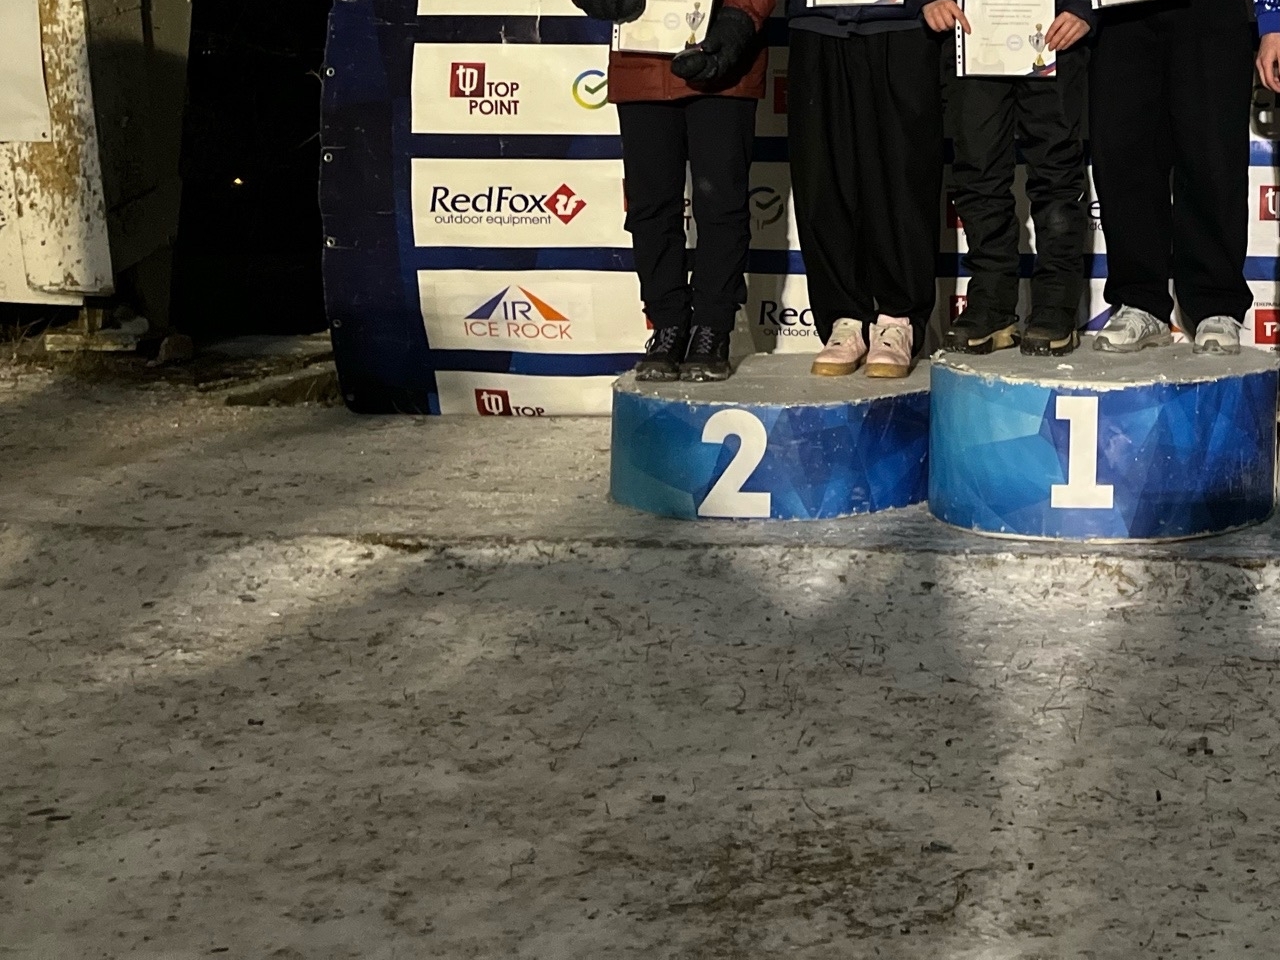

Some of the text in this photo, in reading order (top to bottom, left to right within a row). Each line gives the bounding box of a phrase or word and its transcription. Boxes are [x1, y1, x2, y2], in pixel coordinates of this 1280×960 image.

[487, 82, 520, 97] TOP
[469, 100, 520, 115] POINT
[430, 186, 548, 213] RedFox
[434, 214, 552, 227] outdoor equipment
[464, 322, 573, 339] ICE ROCK
[763, 327, 811, 337] outdoor
[512, 406, 545, 417] TOP
[1050, 395, 1114, 509] 1
[697, 408, 771, 518] 2
